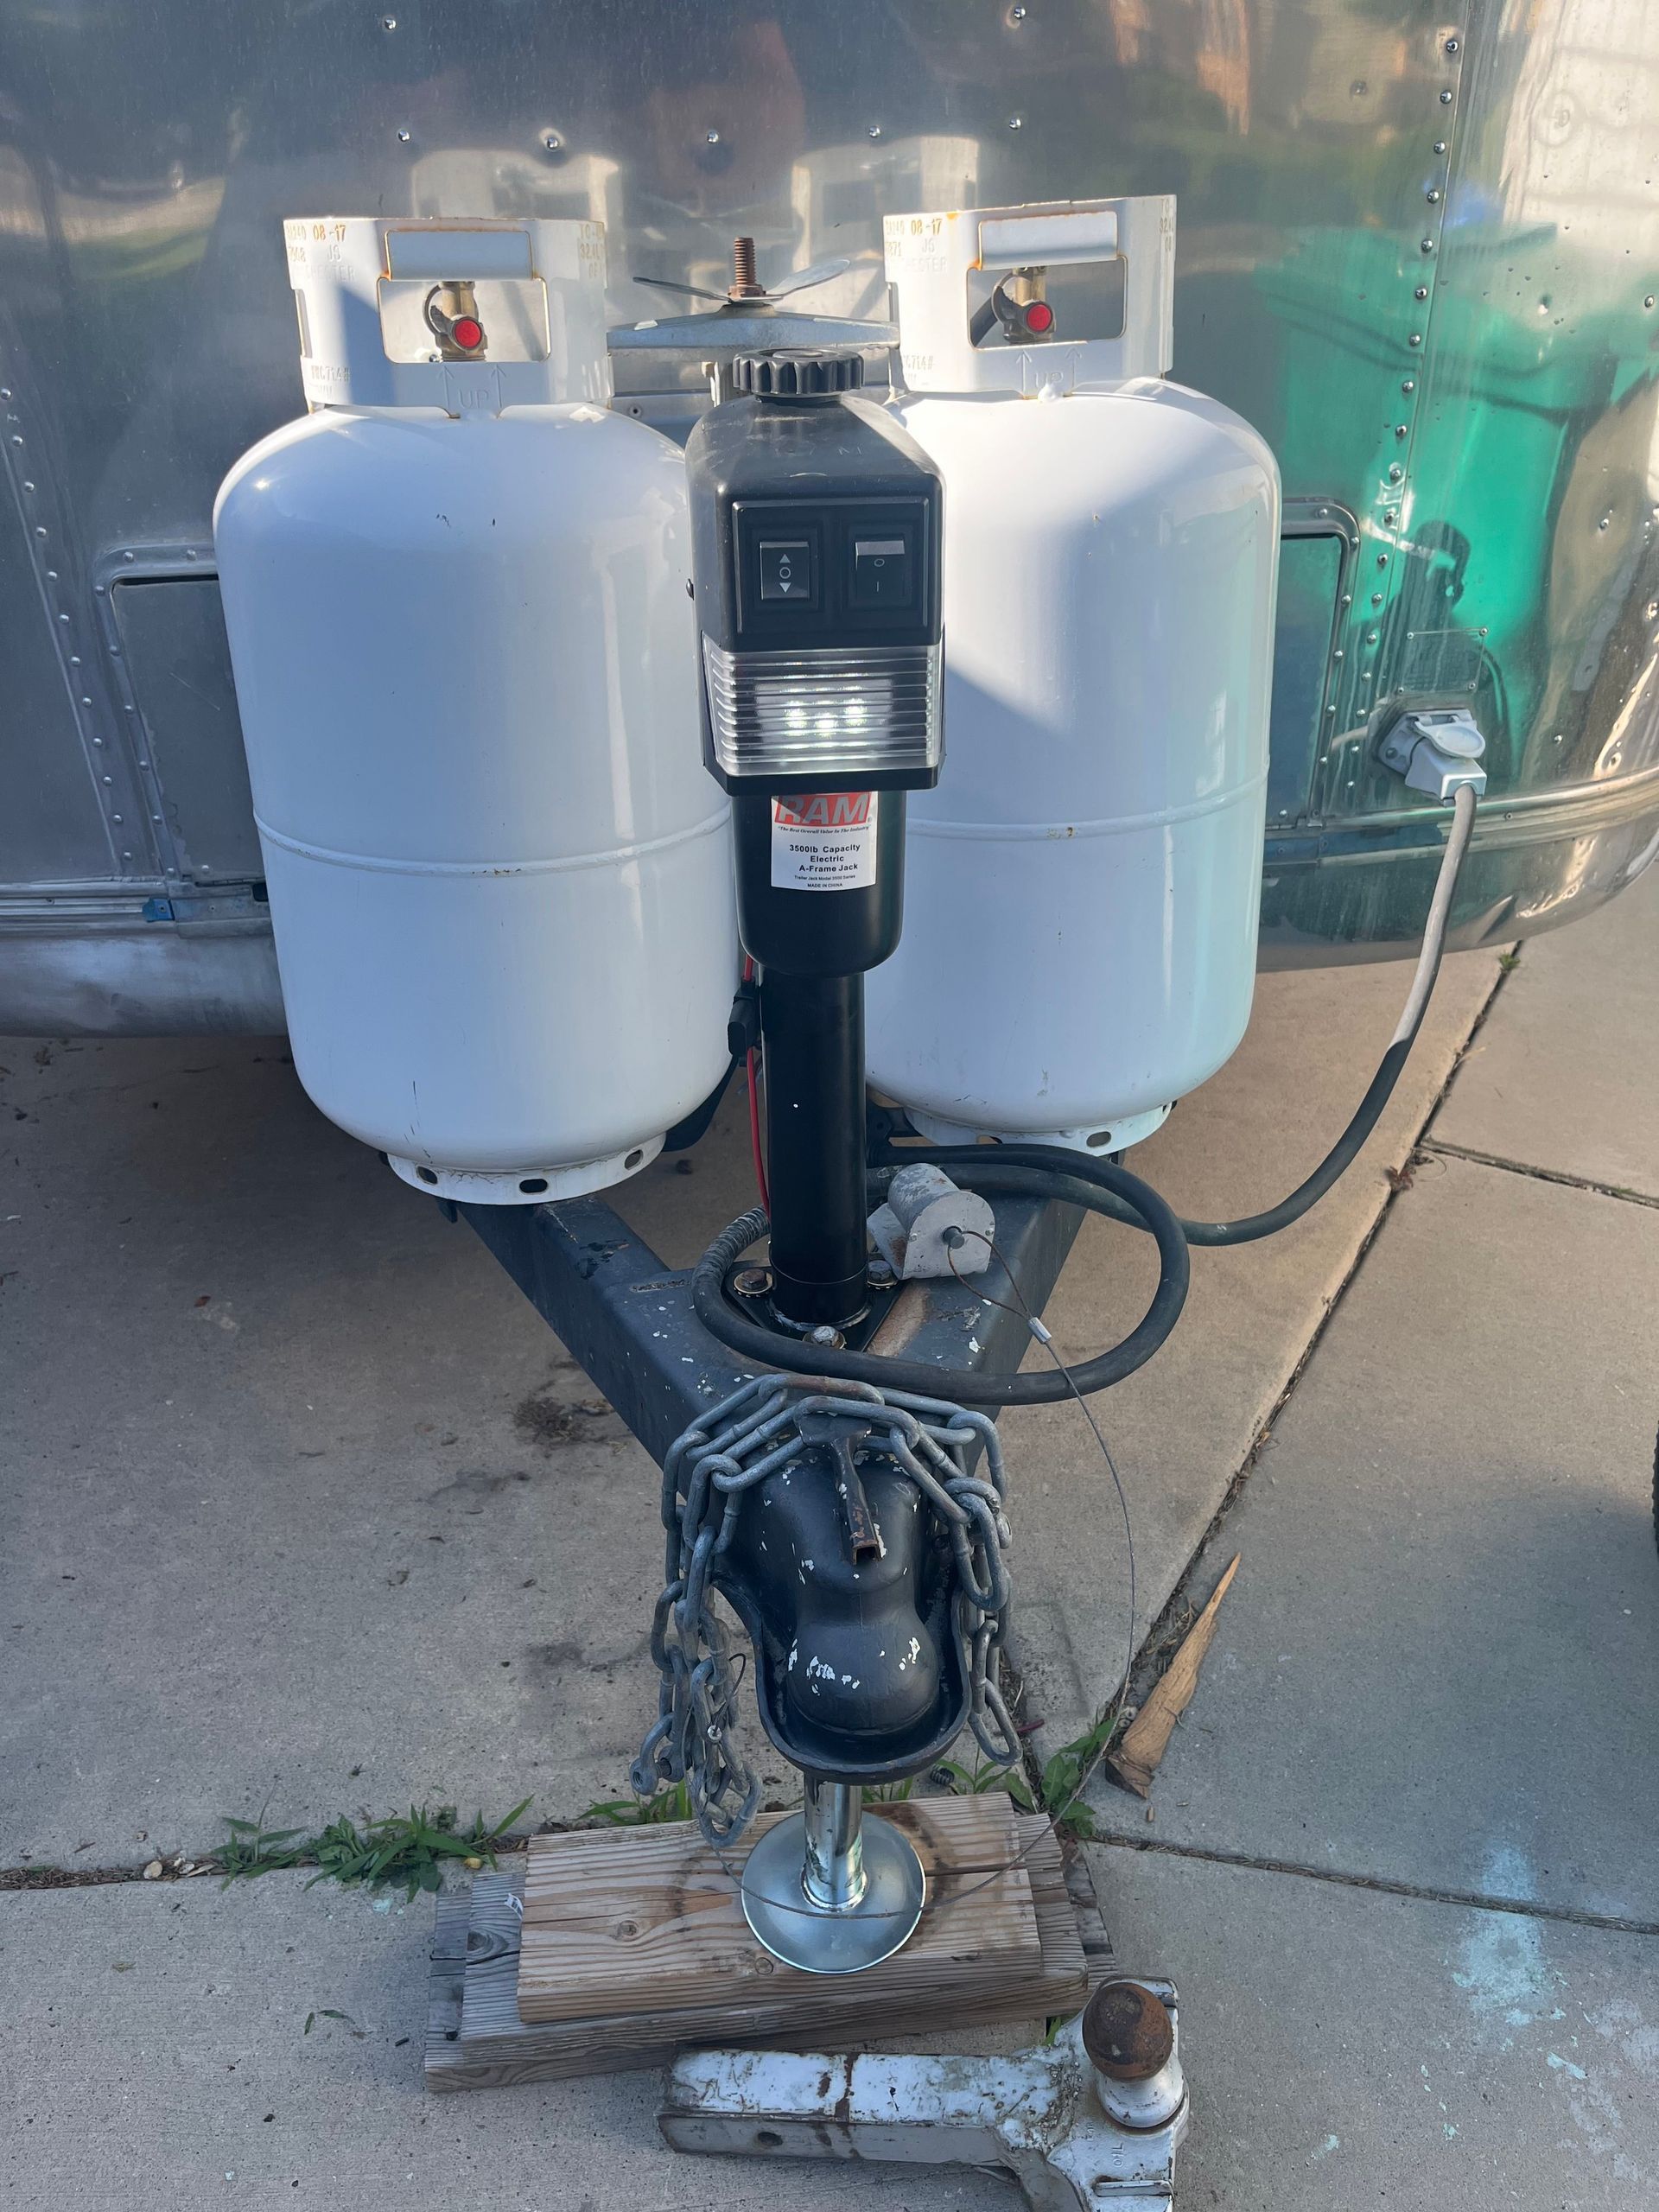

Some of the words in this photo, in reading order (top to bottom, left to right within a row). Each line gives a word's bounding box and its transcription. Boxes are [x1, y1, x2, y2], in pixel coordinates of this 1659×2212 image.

[457, 388, 489, 409] UP
[779, 794, 869, 824] RAM
[789, 843, 818, 854] 3500lb
[823, 843, 861, 855] Capacity
[810, 855, 844, 863] Electric
[798, 864, 837, 873] A-Frame
[838, 862, 859, 872] Jack
